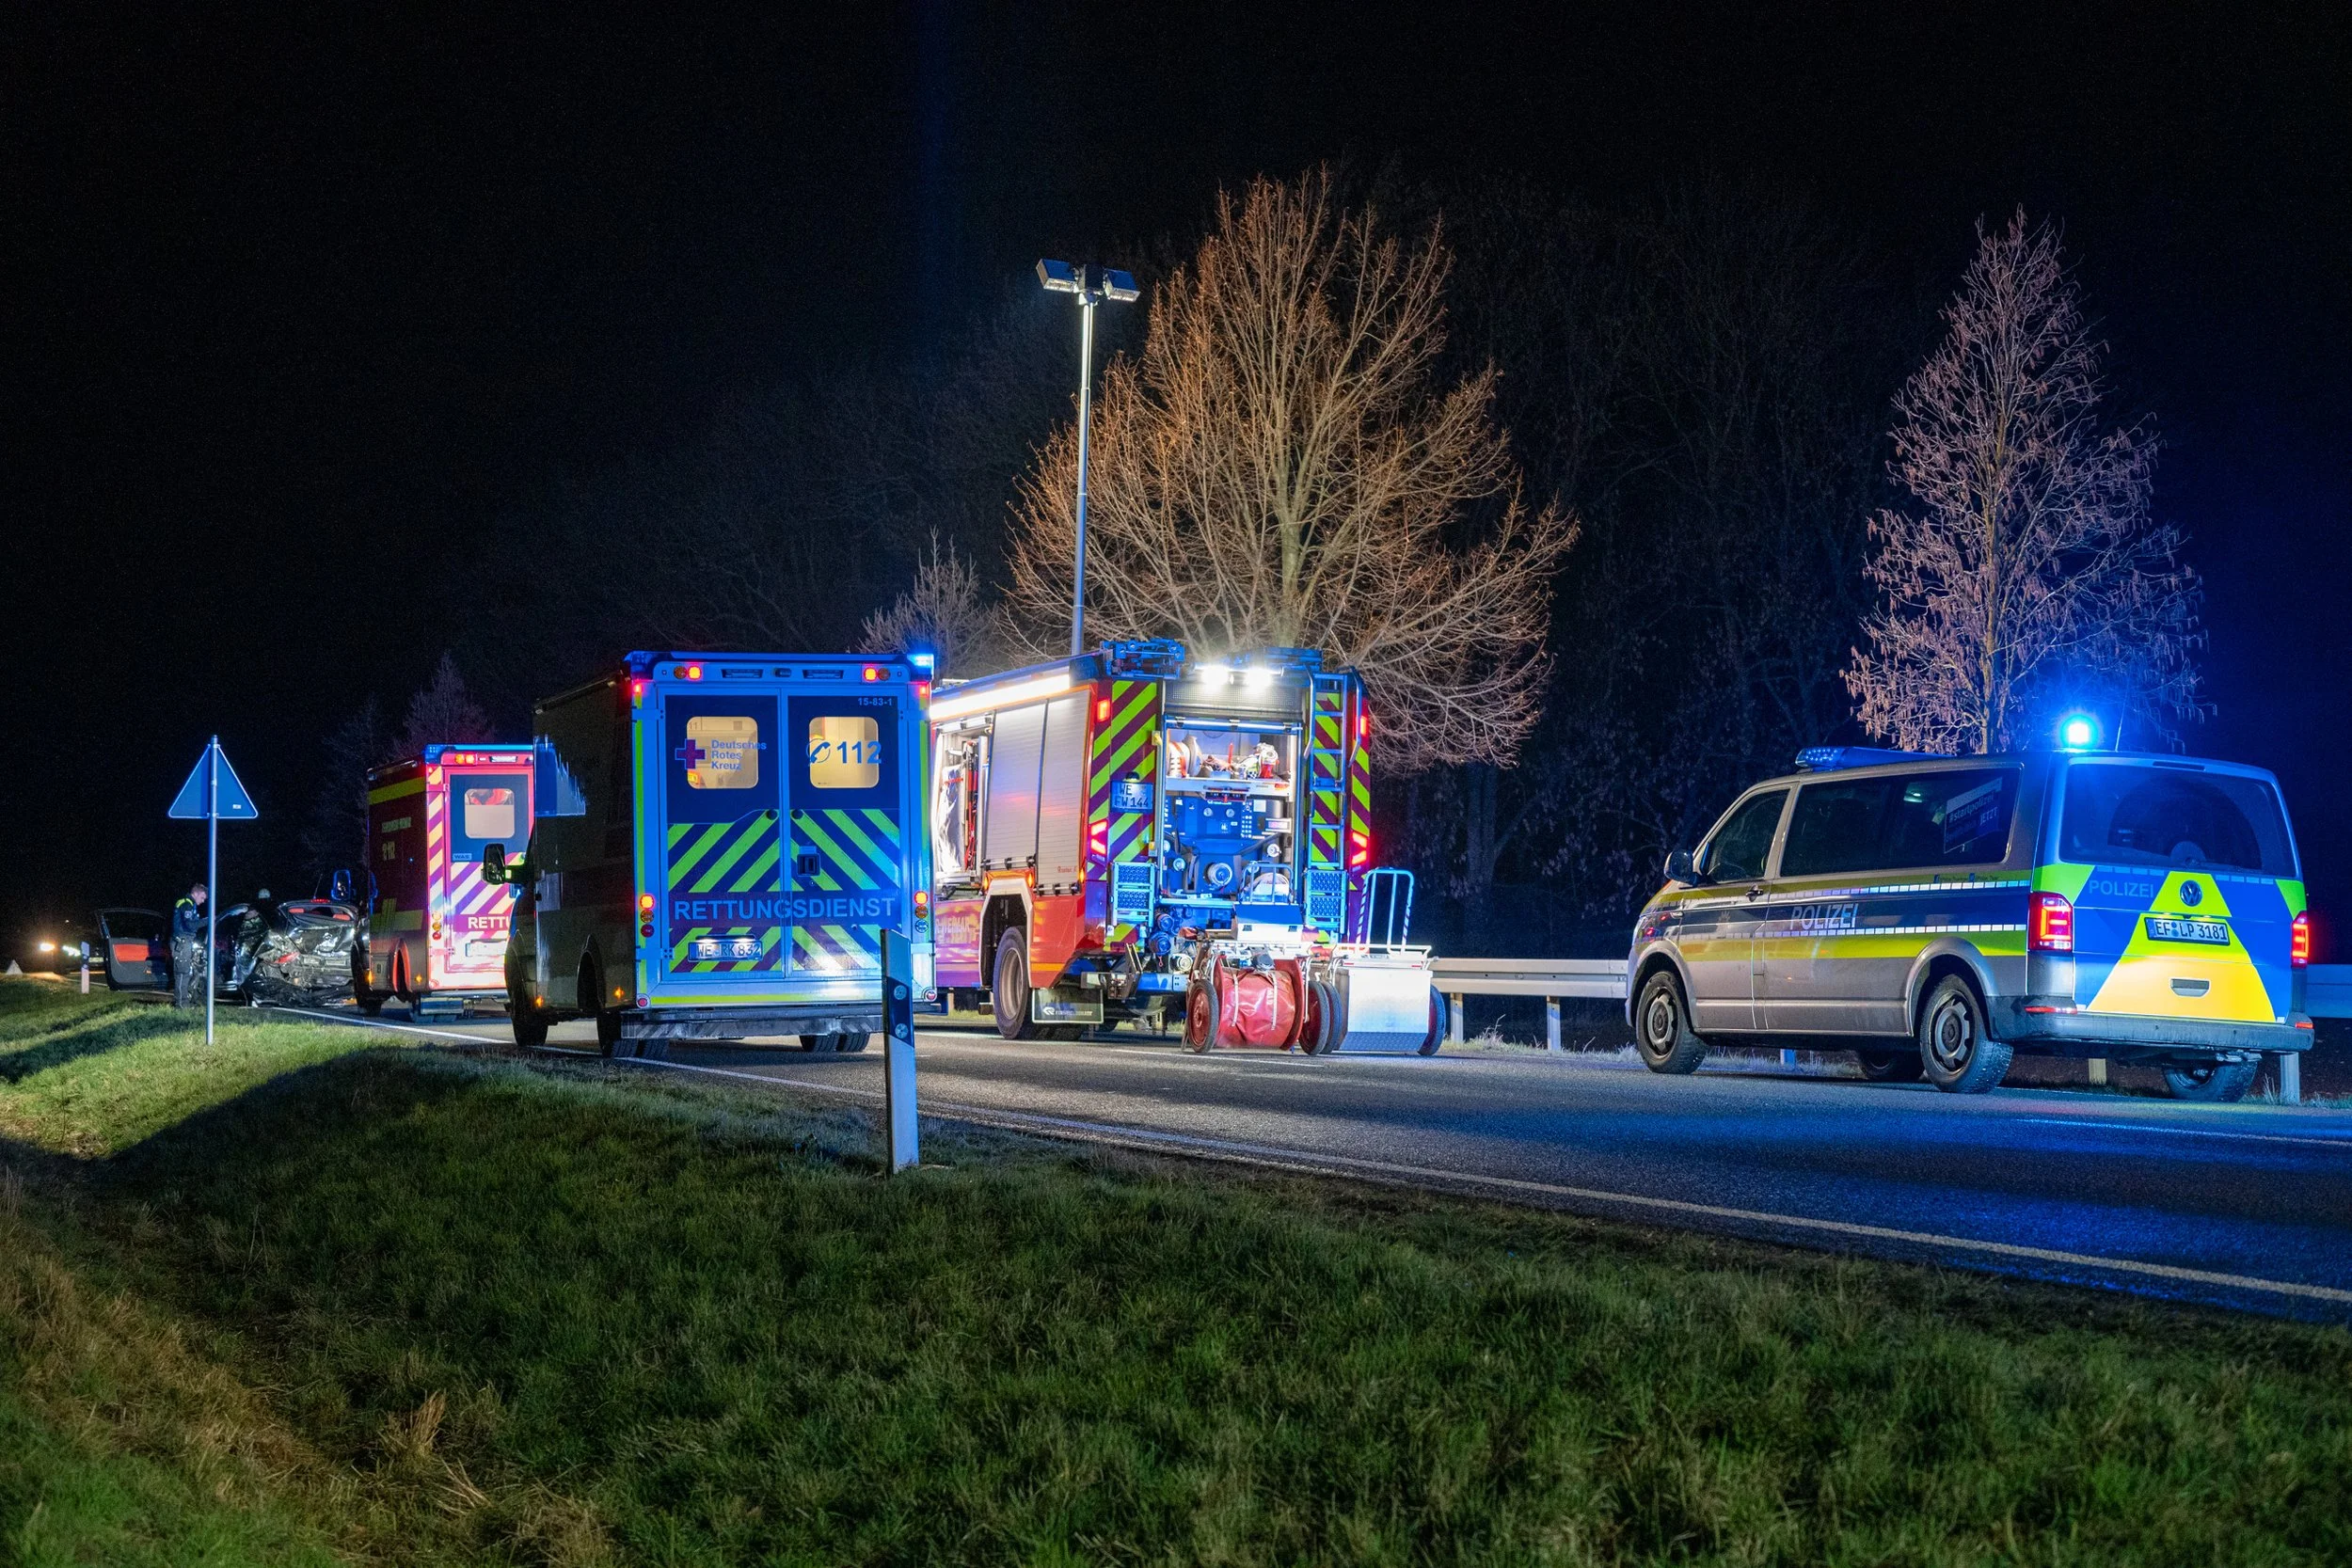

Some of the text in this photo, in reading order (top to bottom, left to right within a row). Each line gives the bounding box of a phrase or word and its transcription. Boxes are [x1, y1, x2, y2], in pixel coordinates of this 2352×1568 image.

[857, 697, 893, 706] 15-83-1
[710, 739, 768, 750] Deutsches
[710, 750, 742, 760] Rotes
[836, 740, 882, 765] 112
[710, 760, 741, 771] Kreuz
[1119, 783, 1133, 796] WE
[1130, 797, 1150, 808] 144
[2089, 879, 2154, 898] POLIZEI
[674, 897, 896, 921] RETTUNGSDIENST
[1789, 903, 1859, 930] POLIZEI
[2154, 921, 2228, 941] EF LP 3181
[697, 943, 762, 958] WE RK 832
